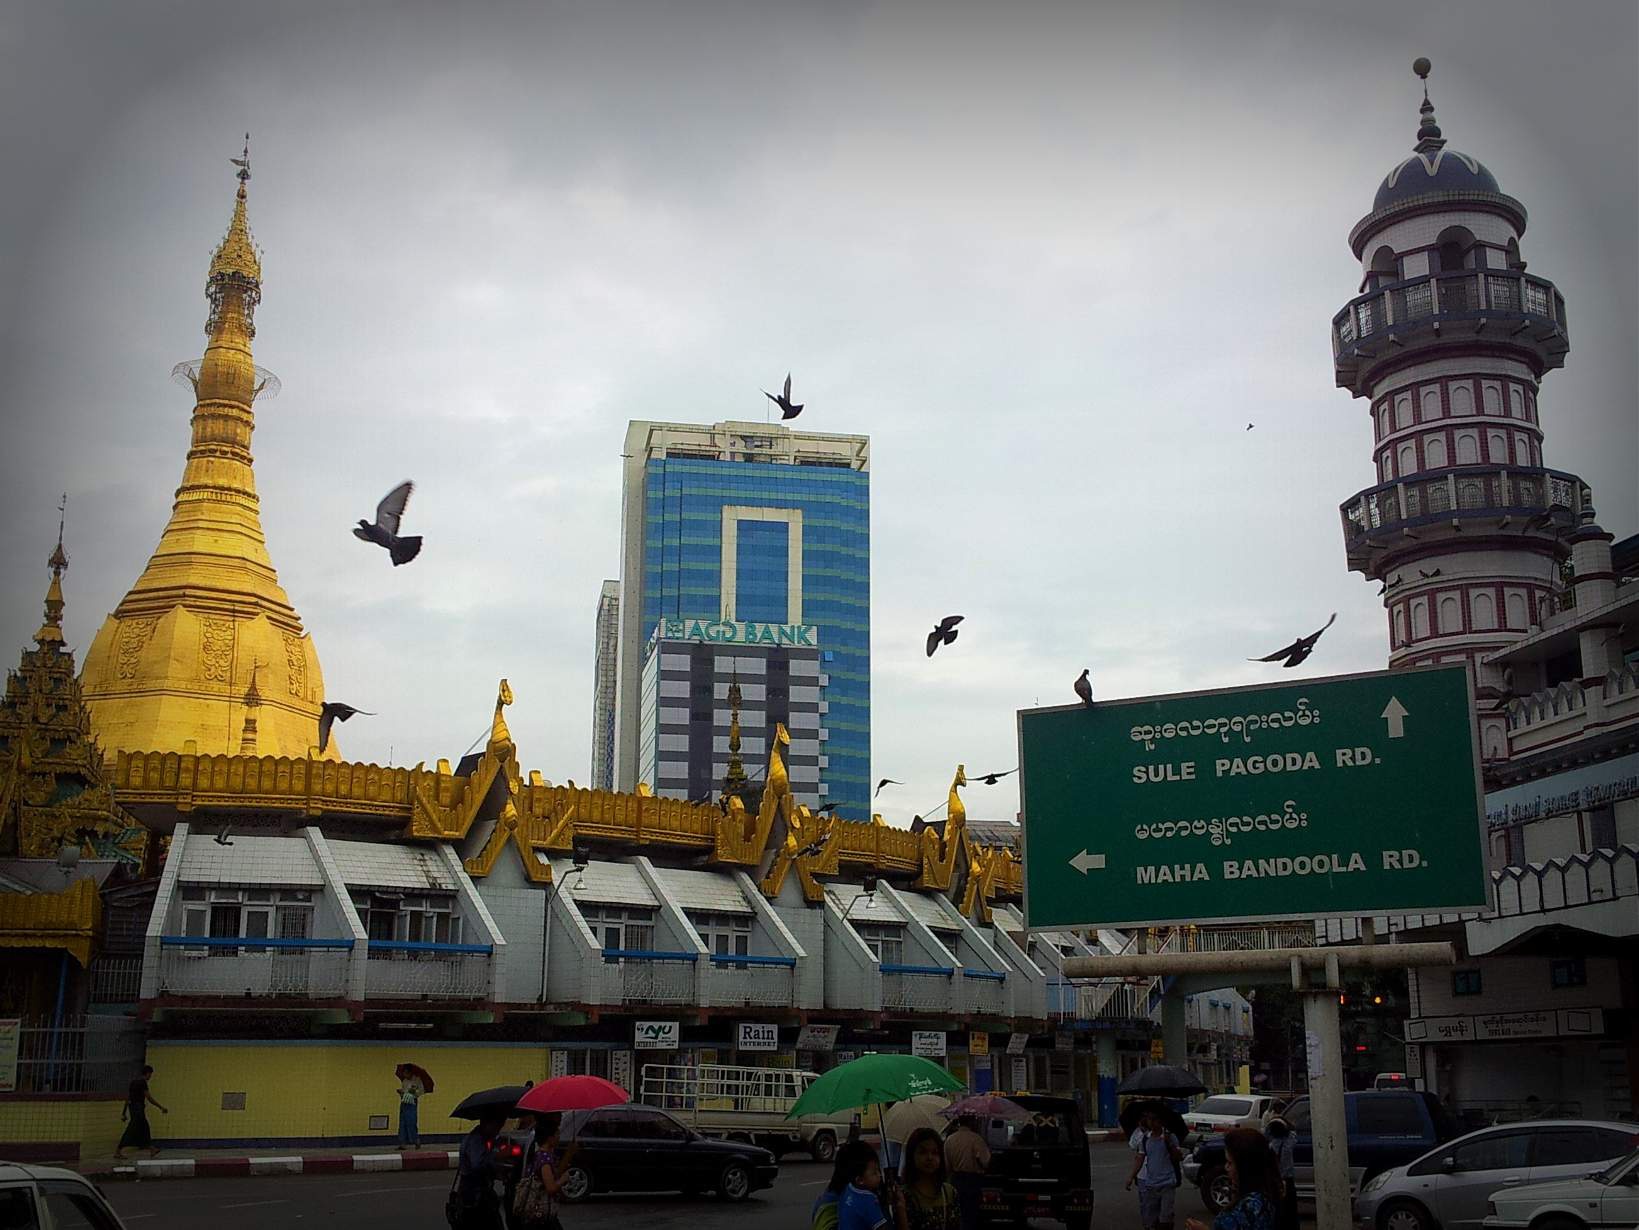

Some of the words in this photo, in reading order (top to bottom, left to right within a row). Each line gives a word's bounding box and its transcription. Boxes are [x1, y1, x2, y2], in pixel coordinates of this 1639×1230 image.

[688, 620, 737, 642] AGD
[744, 621, 813, 646] BANK
[1130, 697, 1319, 751] ဆူးလေဘုရားလမ်း
[1132, 761, 1196, 783] SULE
[1215, 751, 1321, 777] PAGODA
[1335, 746, 1381, 767] RD.
[1136, 863, 1210, 884] MAHA
[1223, 853, 1367, 879] BANDOOLA
[1382, 849, 1429, 870] RD.
[743, 1025, 775, 1040] Rain
